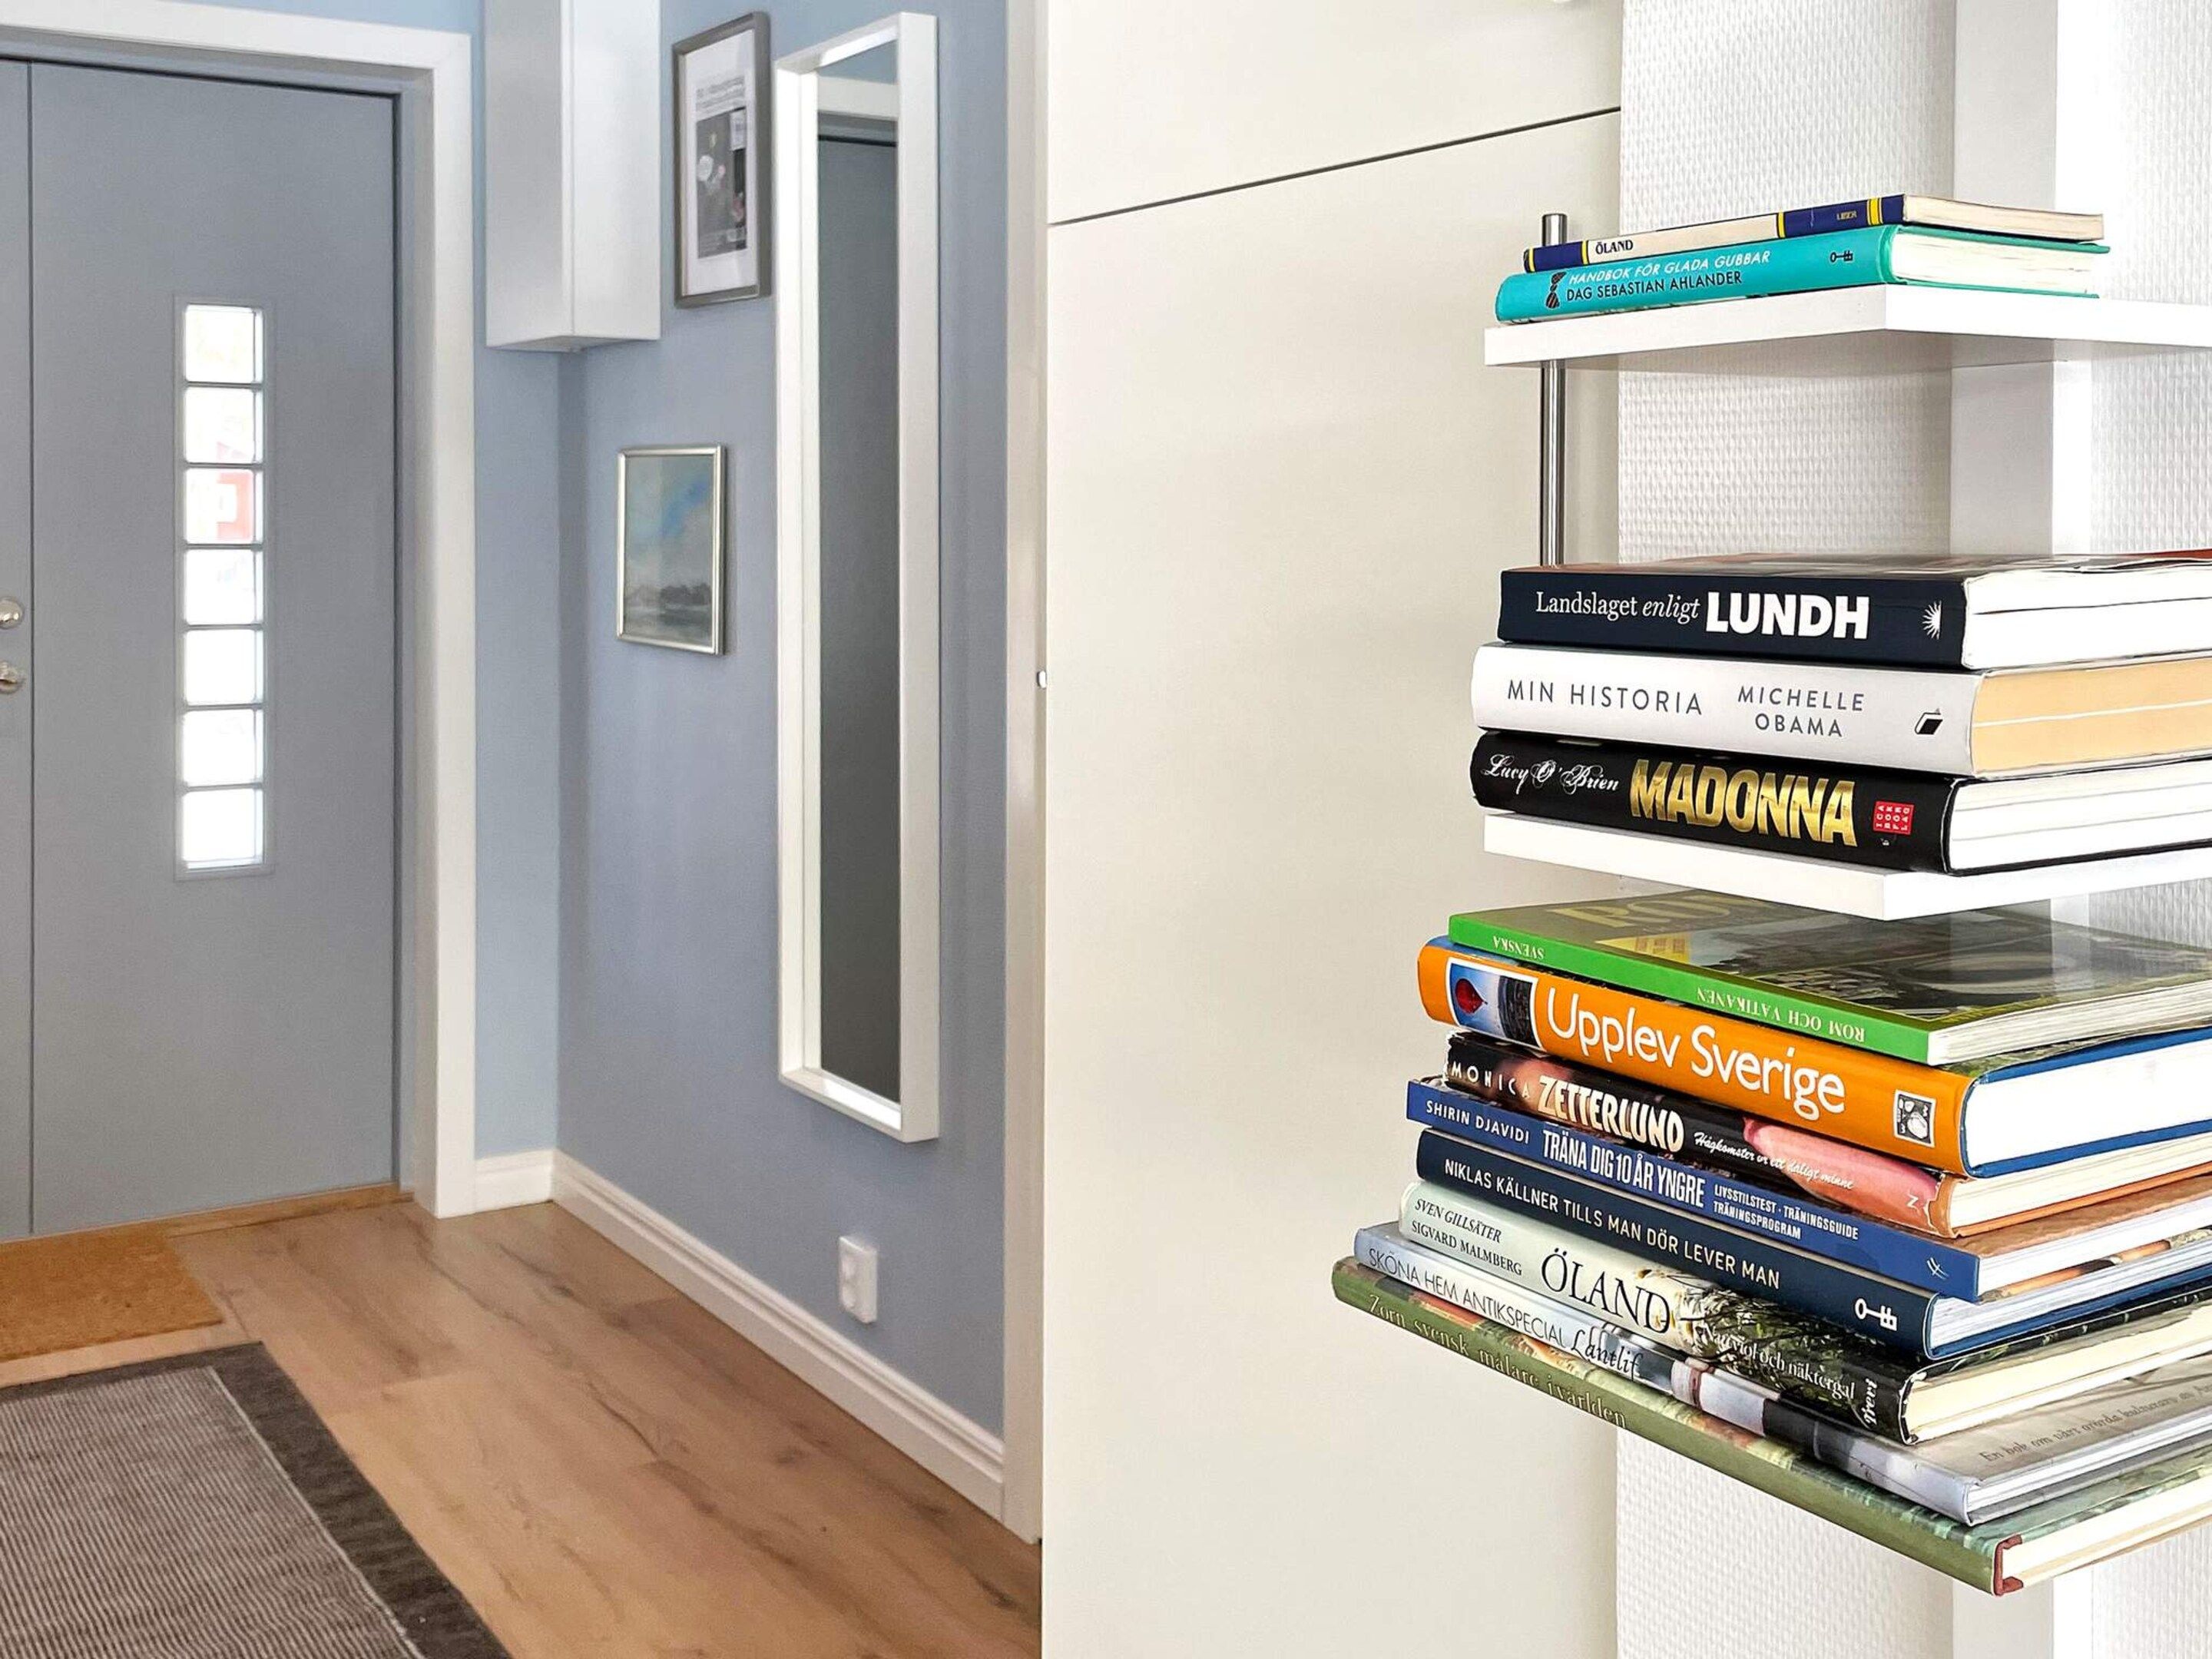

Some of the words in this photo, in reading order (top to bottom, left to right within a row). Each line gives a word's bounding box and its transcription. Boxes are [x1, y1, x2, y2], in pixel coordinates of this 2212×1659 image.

[1569, 267, 1629, 285] HANDBOK
[1635, 262, 1660, 277] FÖR
[1664, 259, 1709, 274] GLADA
[1714, 250, 1772, 267] GUBBAR
[1595, 240, 1634, 254] ÖLAND
[1567, 286, 1592, 301] DAG
[1598, 278, 1665, 299] SEBASTIAN
[1670, 270, 1742, 290] AHLANDER
[1535, 591, 1637, 621] Landslaget
[1642, 594, 1701, 624] enligt
[1705, 591, 1870, 640] LUNDH
[1507, 679, 1555, 703] MIN
[1570, 684, 1703, 716] HISTORIA
[1737, 686, 1865, 712] MICHELLE
[1754, 713, 1843, 737] OBAMA
[1481, 753, 1529, 795] Lucy
[1628, 759, 1858, 847] MADONNA
[1492, 935, 1545, 960] SVENSKA
[1697, 989, 1781, 1023] VATIKANEN
[1787, 1009, 1822, 1031] OCH
[1828, 1020, 1866, 1043] ROM
[1547, 987, 1681, 1068] Upplev
[1690, 1024, 1846, 1121] Sverige
[1450, 1061, 1531, 1099] MONICA
[1538, 1075, 1685, 1152] ZETTERLUND
[1426, 1100, 1470, 1126] SHIRIN
[1475, 1115, 1530, 1145] DJAVIDI
[1542, 1130, 1588, 1171] TRÄNA
[1590, 1144, 1614, 1179] DIG
[1615, 1153, 1633, 1184] 10
[1633, 1153, 1654, 1191] ÅR
[1657, 1164, 1706, 1208] YNGRE
[1694, 1132, 1755, 1161] Hågkomster
[1415, 1198, 1443, 1220] SVEN
[1444, 1210, 1502, 1244] GILLSÄTER
[1444, 1158, 1492, 1189] NIKLAS
[1496, 1176, 1559, 1213] KÄLLNER
[1563, 1198, 1602, 1227] TILLS
[1608, 1214, 1641, 1241] MAN
[1646, 1228, 1679, 1255] DÖR
[1684, 1240, 1736, 1274] LEVER
[1741, 1260, 1780, 1290] MAN
[1713, 1200, 1802, 1240] TRÄNINGSPROGRAM
[1714, 1184, 1777, 1214] LIVSSTILSTEST
[1783, 1205, 1859, 1240] TRÄNINGSGUIDE
[1411, 1220, 1458, 1249] SIGVARD
[1459, 1240, 1522, 1277] MALMBERG
[1369, 1248, 1421, 1286] SKÖNA
[1425, 1270, 1459, 1302] HEM
[1463, 1289, 1567, 1349] ANTIKSPECIAL
[1541, 1247, 1671, 1334] ÖLAND
[1369, 1294, 1406, 1328] Zorn
[1414, 1320, 1469, 1356] svensk
[1759, 1352, 1785, 1372] och
[1788, 1363, 1856, 1400] näktergal
